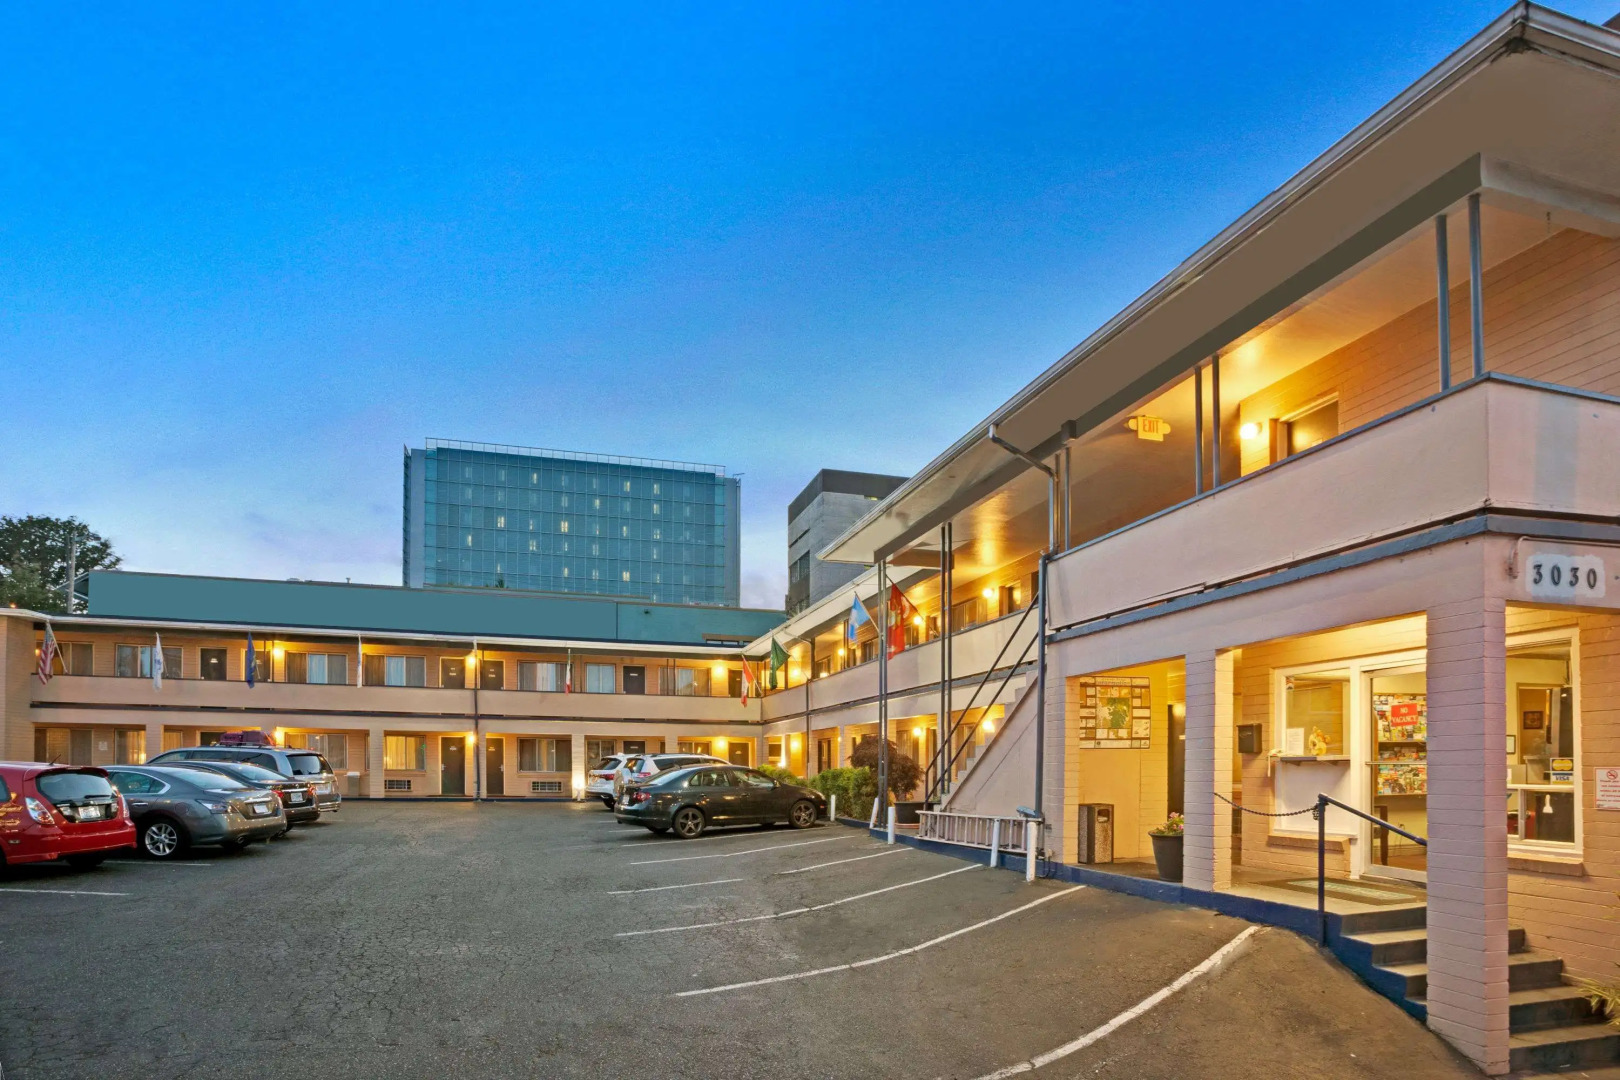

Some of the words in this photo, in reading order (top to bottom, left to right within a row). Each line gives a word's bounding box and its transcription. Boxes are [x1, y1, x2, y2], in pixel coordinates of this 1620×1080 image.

[1142, 418, 1160, 434] EXIT
[1533, 563, 1597, 590] 3030
[1391, 715, 1418, 723] VACANCY
